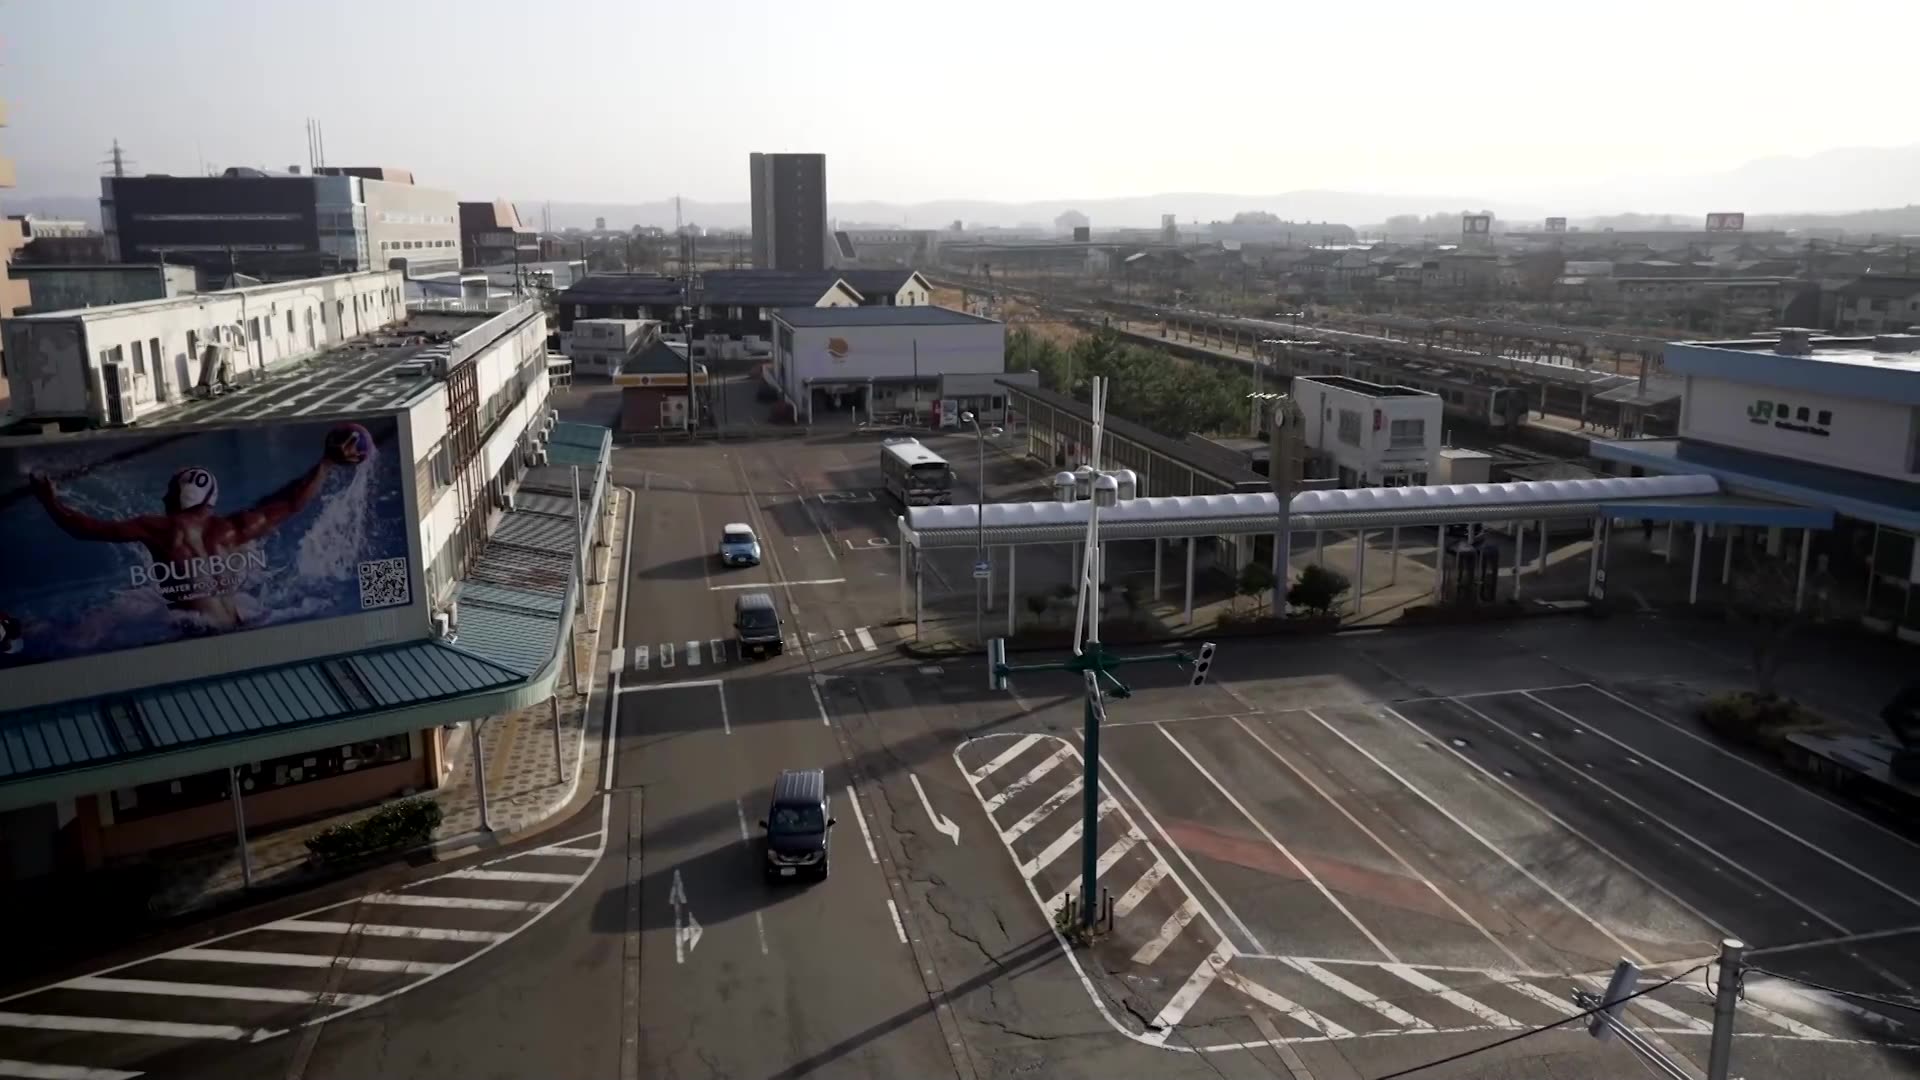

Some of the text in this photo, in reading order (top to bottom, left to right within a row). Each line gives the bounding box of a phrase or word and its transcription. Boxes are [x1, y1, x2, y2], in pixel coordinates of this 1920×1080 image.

[1747, 400, 1773, 419] JR
[187, 471, 209, 487] 10
[129, 549, 267, 586] BOURBON
[160, 583, 191, 594] WATER
